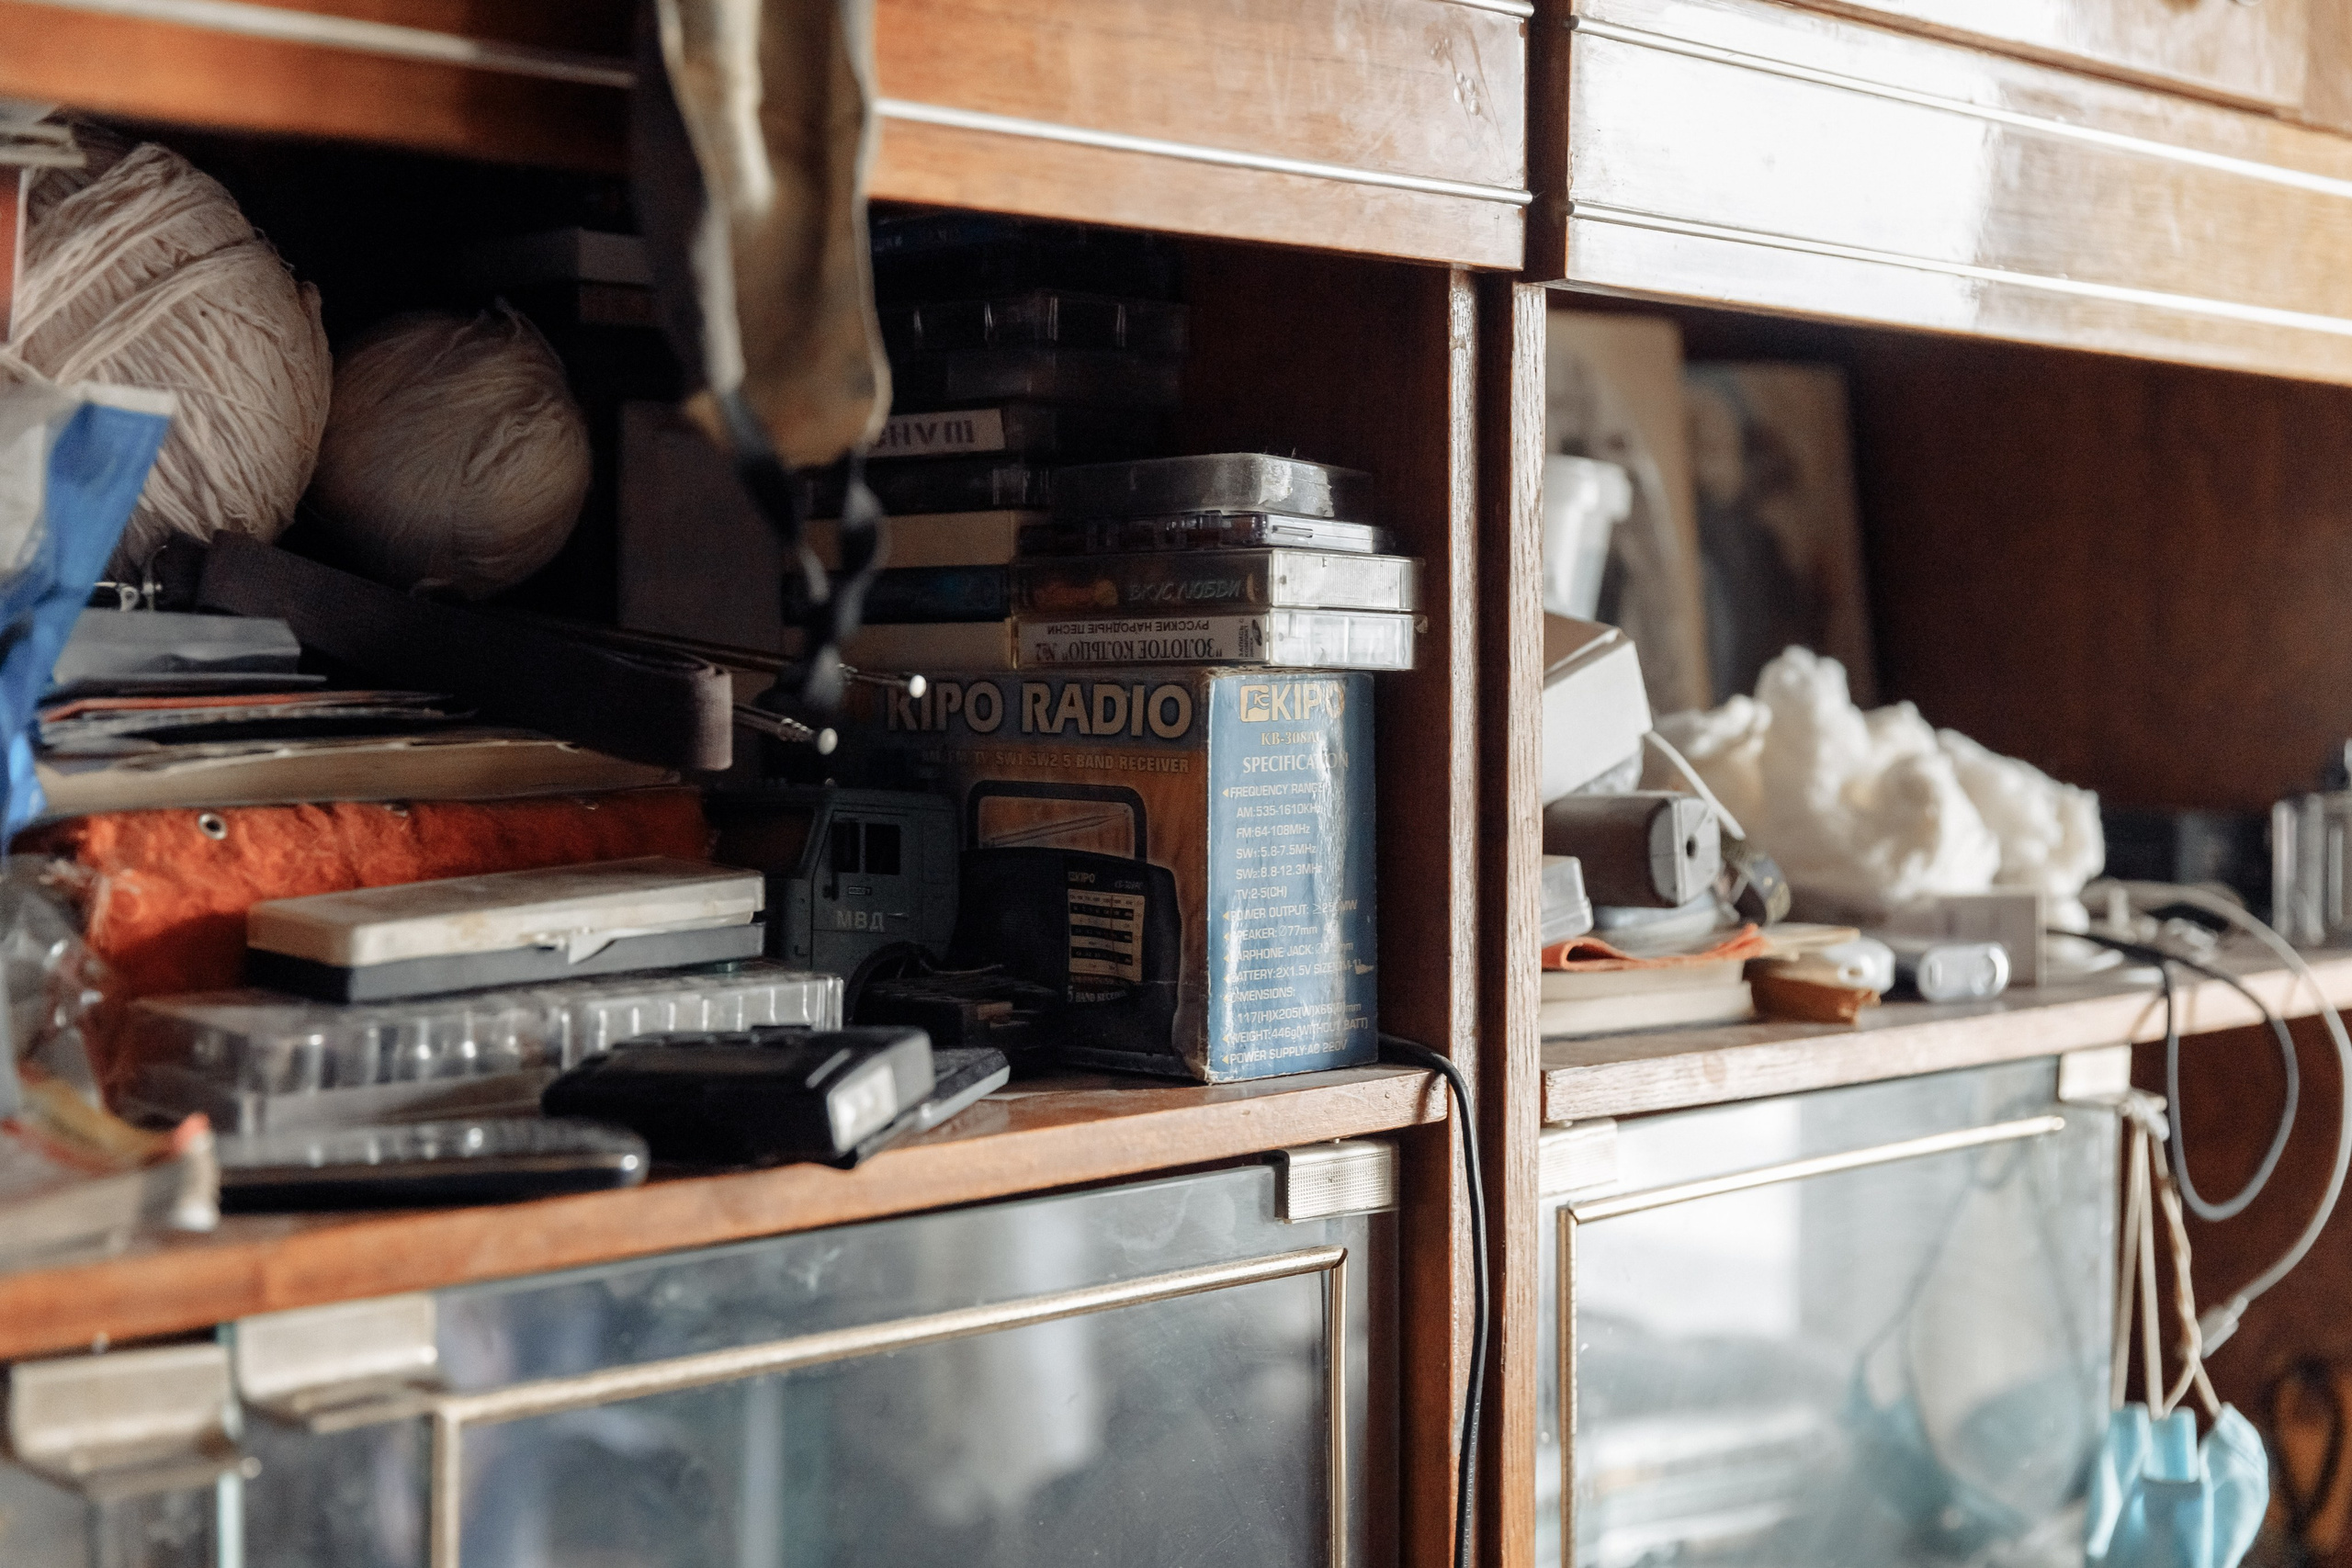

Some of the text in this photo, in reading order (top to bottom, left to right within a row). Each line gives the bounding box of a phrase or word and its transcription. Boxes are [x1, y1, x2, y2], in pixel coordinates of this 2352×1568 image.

[1046, 619, 1210, 635] РУССКИЕ НАРОДНЫЕ ПЕСНИ
[1060, 636, 1135, 661] КОЛЬЦО"
[1137, 637, 1223, 660] "ЗОЛОТОЕ
[888, 681, 1193, 739] KIPO RADIO
[1271, 681, 1345, 721] KIPO
[1075, 754, 1114, 770] BAND
[1119, 755, 1190, 773] RECEIVER
[1242, 751, 1349, 773] SPECIFICATON
[1229, 784, 1287, 798] FREQUENCY
[1236, 823, 1311, 839] FM:64-108MHz
[1236, 885, 1287, 900] TV:2-5(CH)
[835, 910, 886, 933] МВД
[1230, 908, 1267, 922] POWER
[1269, 904, 1310, 918] OUTPUT:
[1231, 948, 1284, 964] ARPHONE
[1229, 1050, 1268, 1066] POWER
